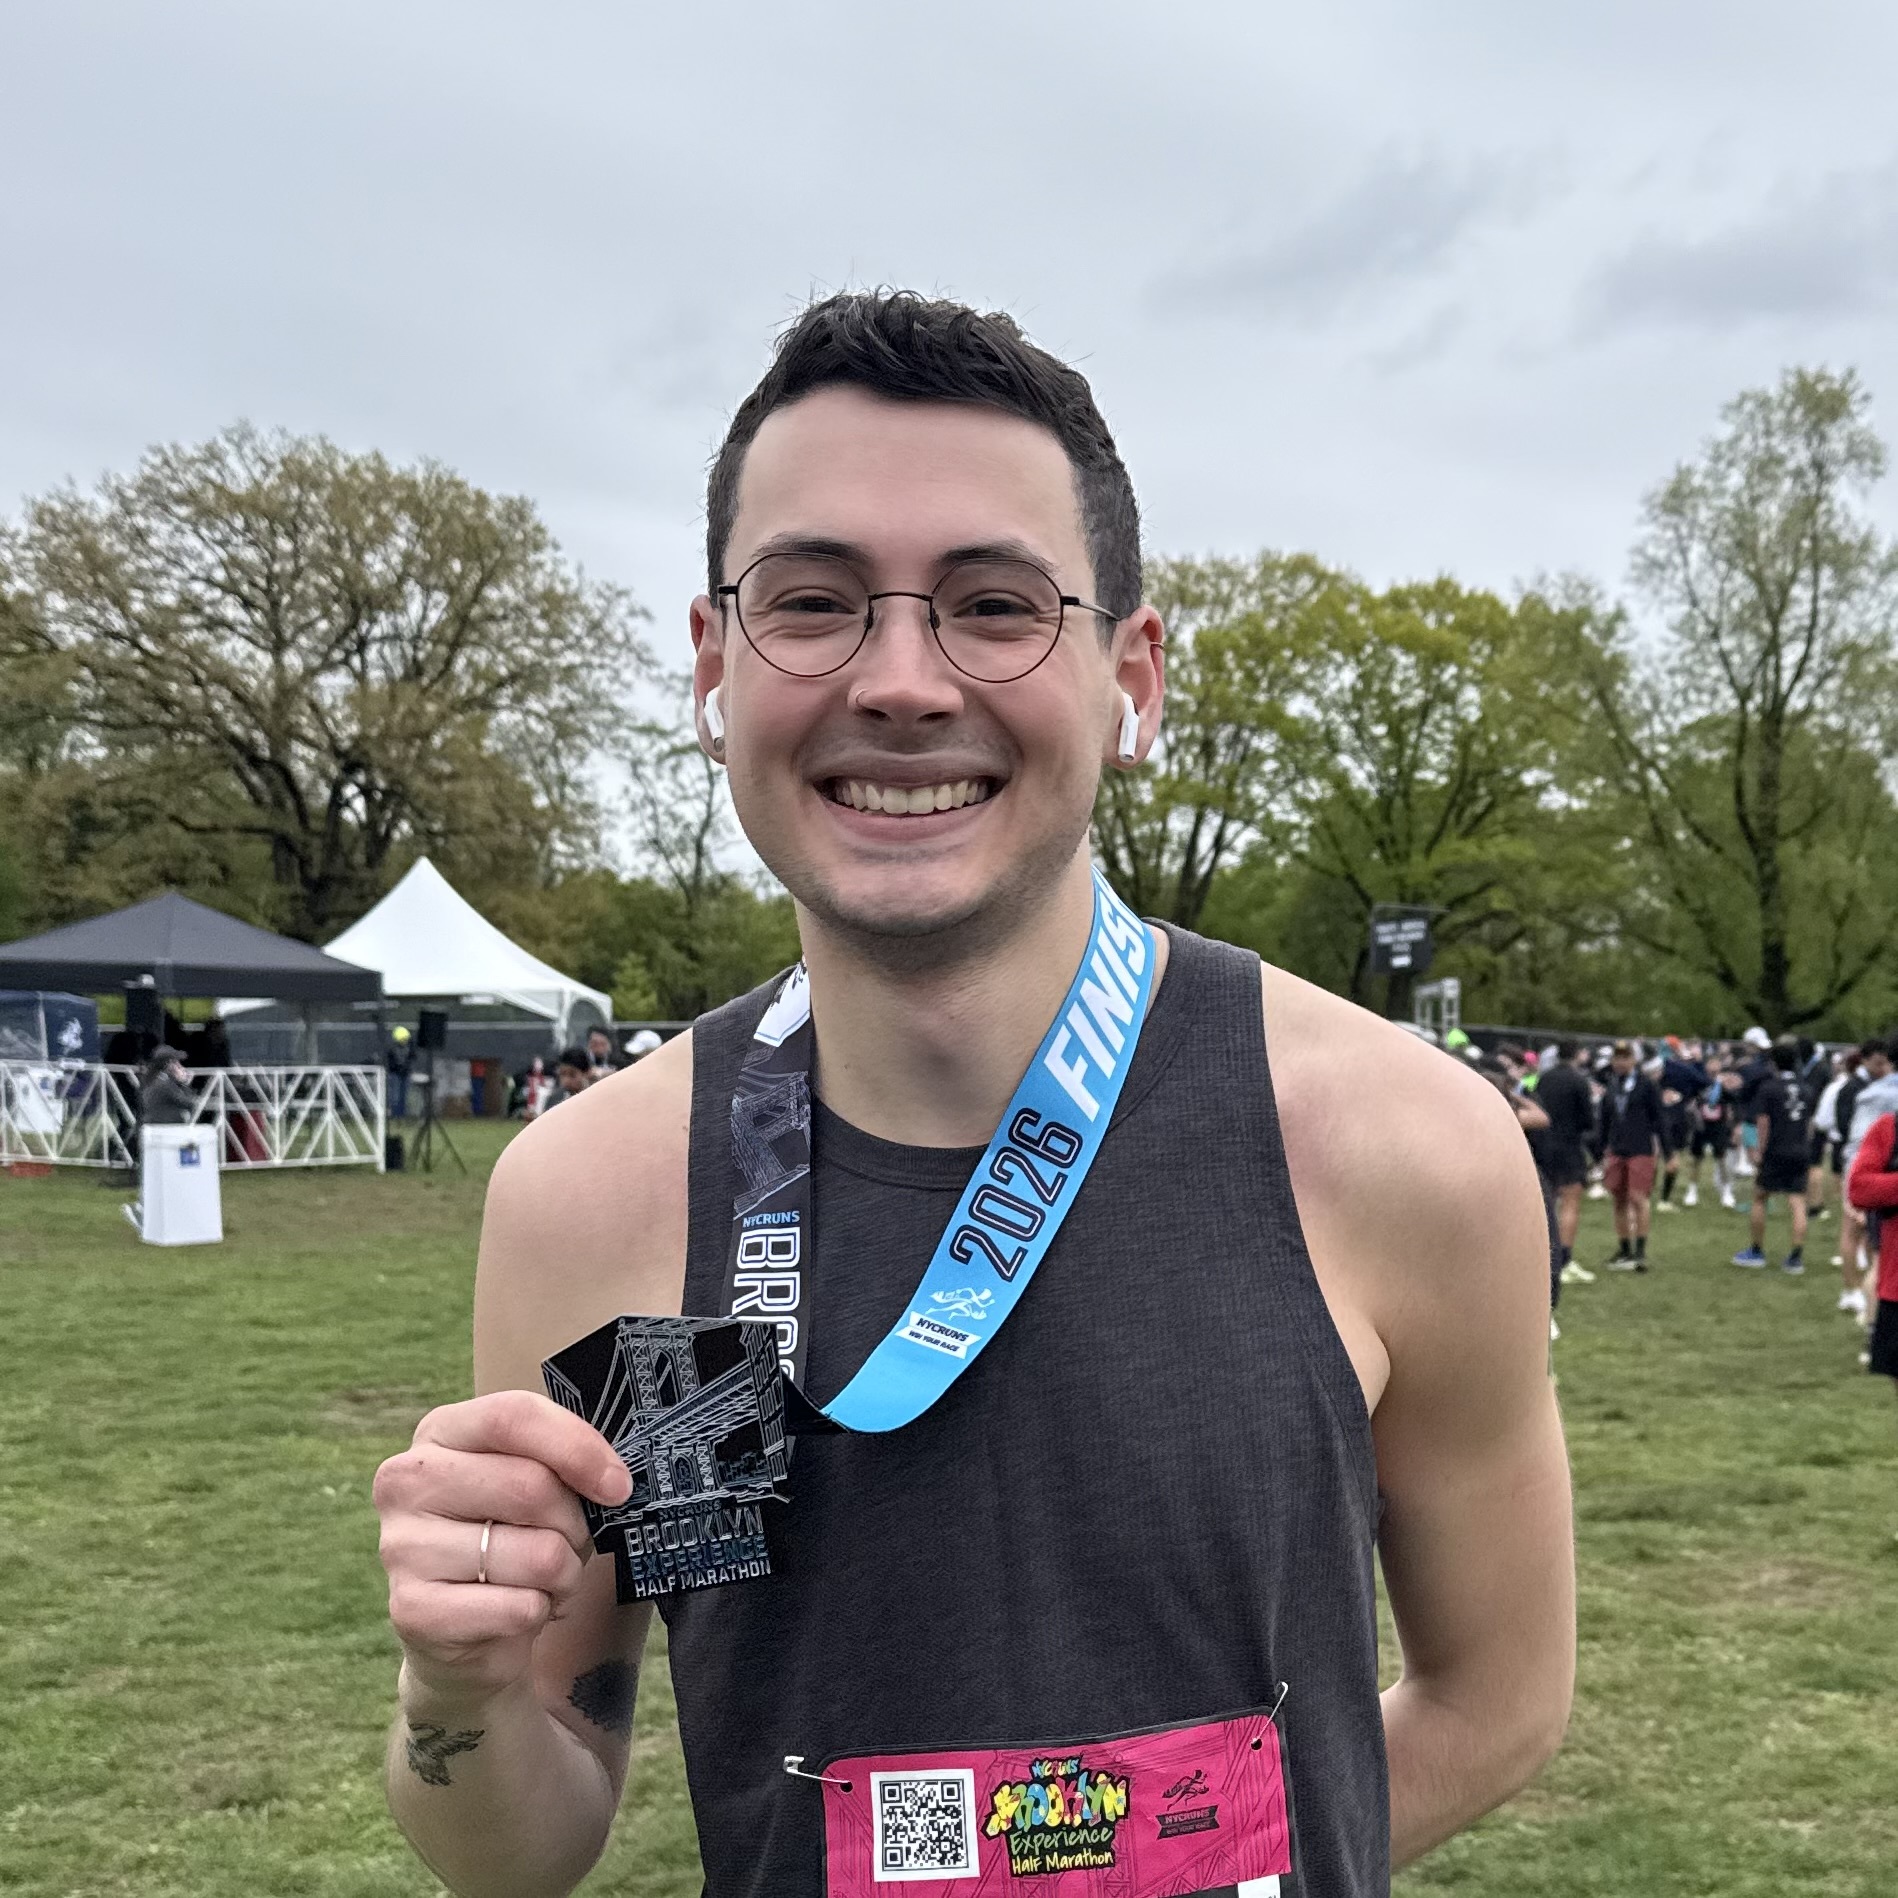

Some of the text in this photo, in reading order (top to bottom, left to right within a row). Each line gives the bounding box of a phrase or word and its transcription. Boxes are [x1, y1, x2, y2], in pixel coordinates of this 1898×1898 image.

[949, 1107, 1083, 1282] 2026
[742, 1210, 800, 1228] NYCRUNS
[916, 1318, 969, 1342] NYCRUNS
[624, 1504, 764, 1557] BROOKLYN
[629, 1534, 769, 1580] EXPERIENCE
[634, 1559, 771, 1598] HALF MARATHON
[1009, 1826, 1114, 1856] Experience
[1046, 1847, 1114, 1872] Marathon
